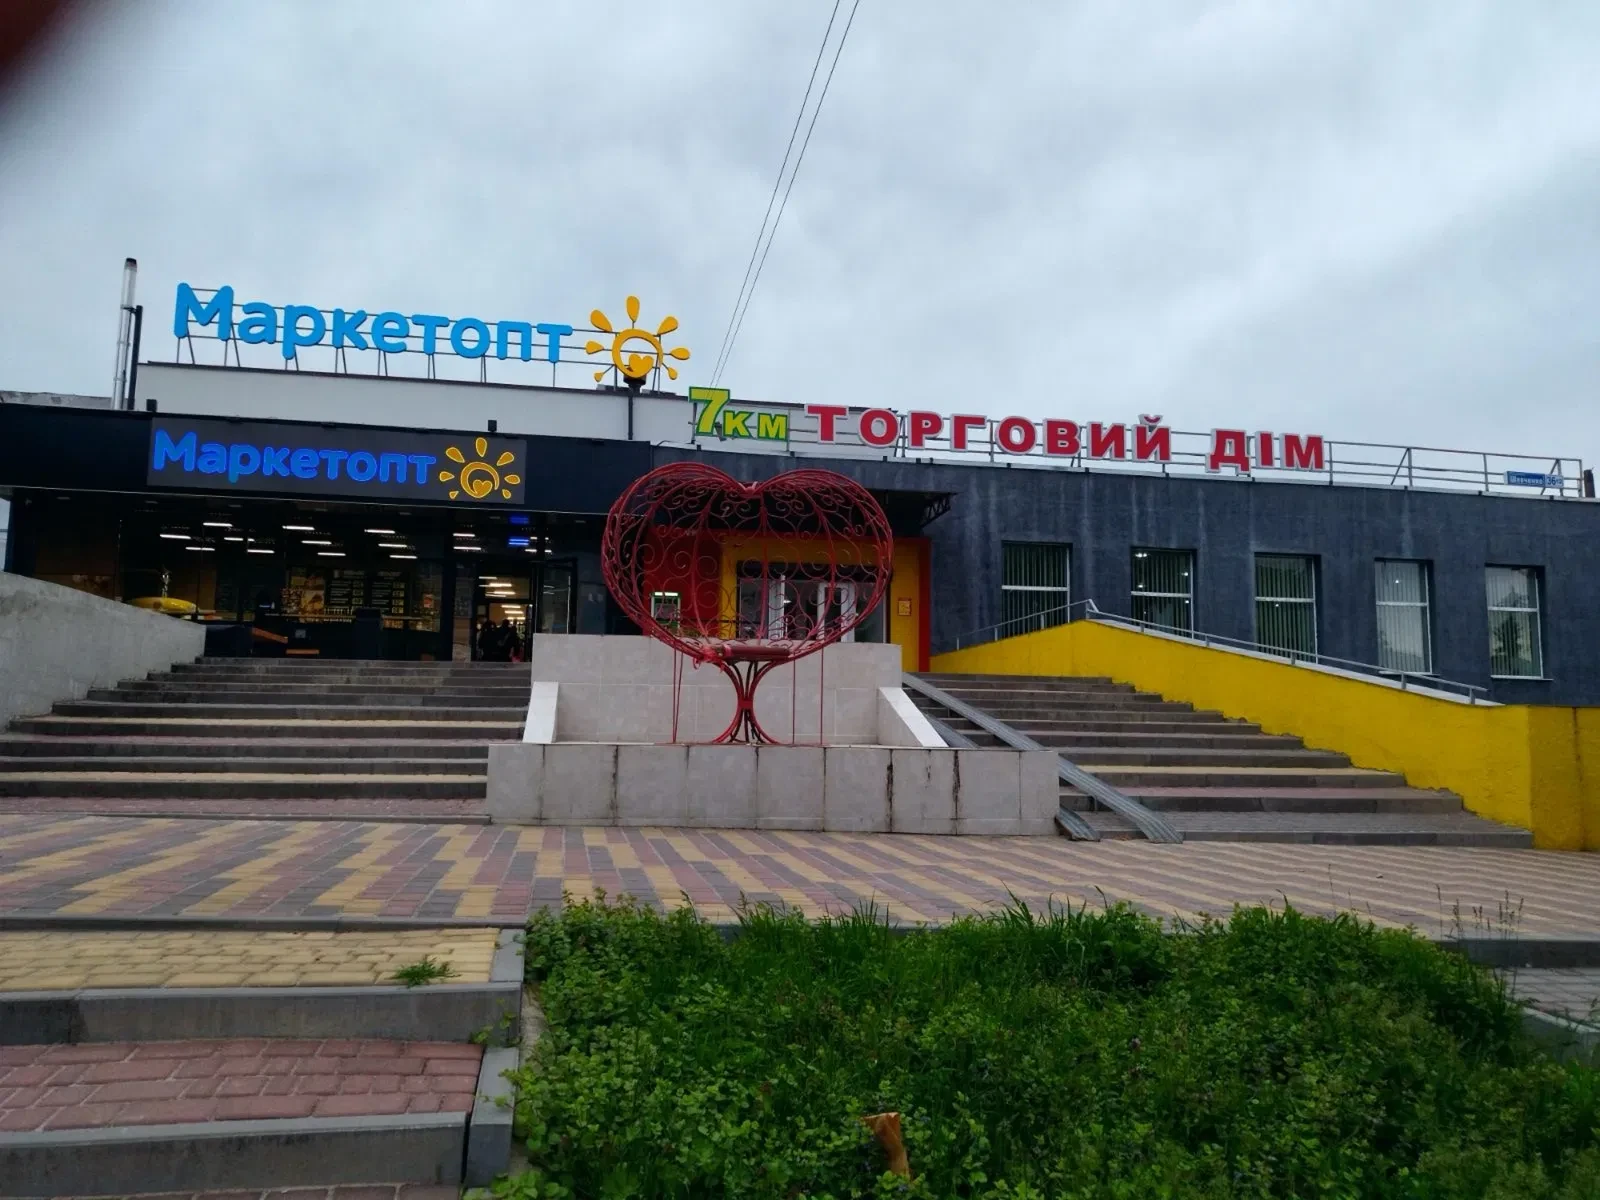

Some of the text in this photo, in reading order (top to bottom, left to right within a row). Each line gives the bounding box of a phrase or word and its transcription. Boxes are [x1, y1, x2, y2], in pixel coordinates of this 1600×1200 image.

[174, 282, 573, 363] Маркетопт
[152, 429, 437, 484] Маркетопт
[804, 403, 1172, 463] ТОРГОВИЙ
[1205, 427, 1326, 477] ДІМ
